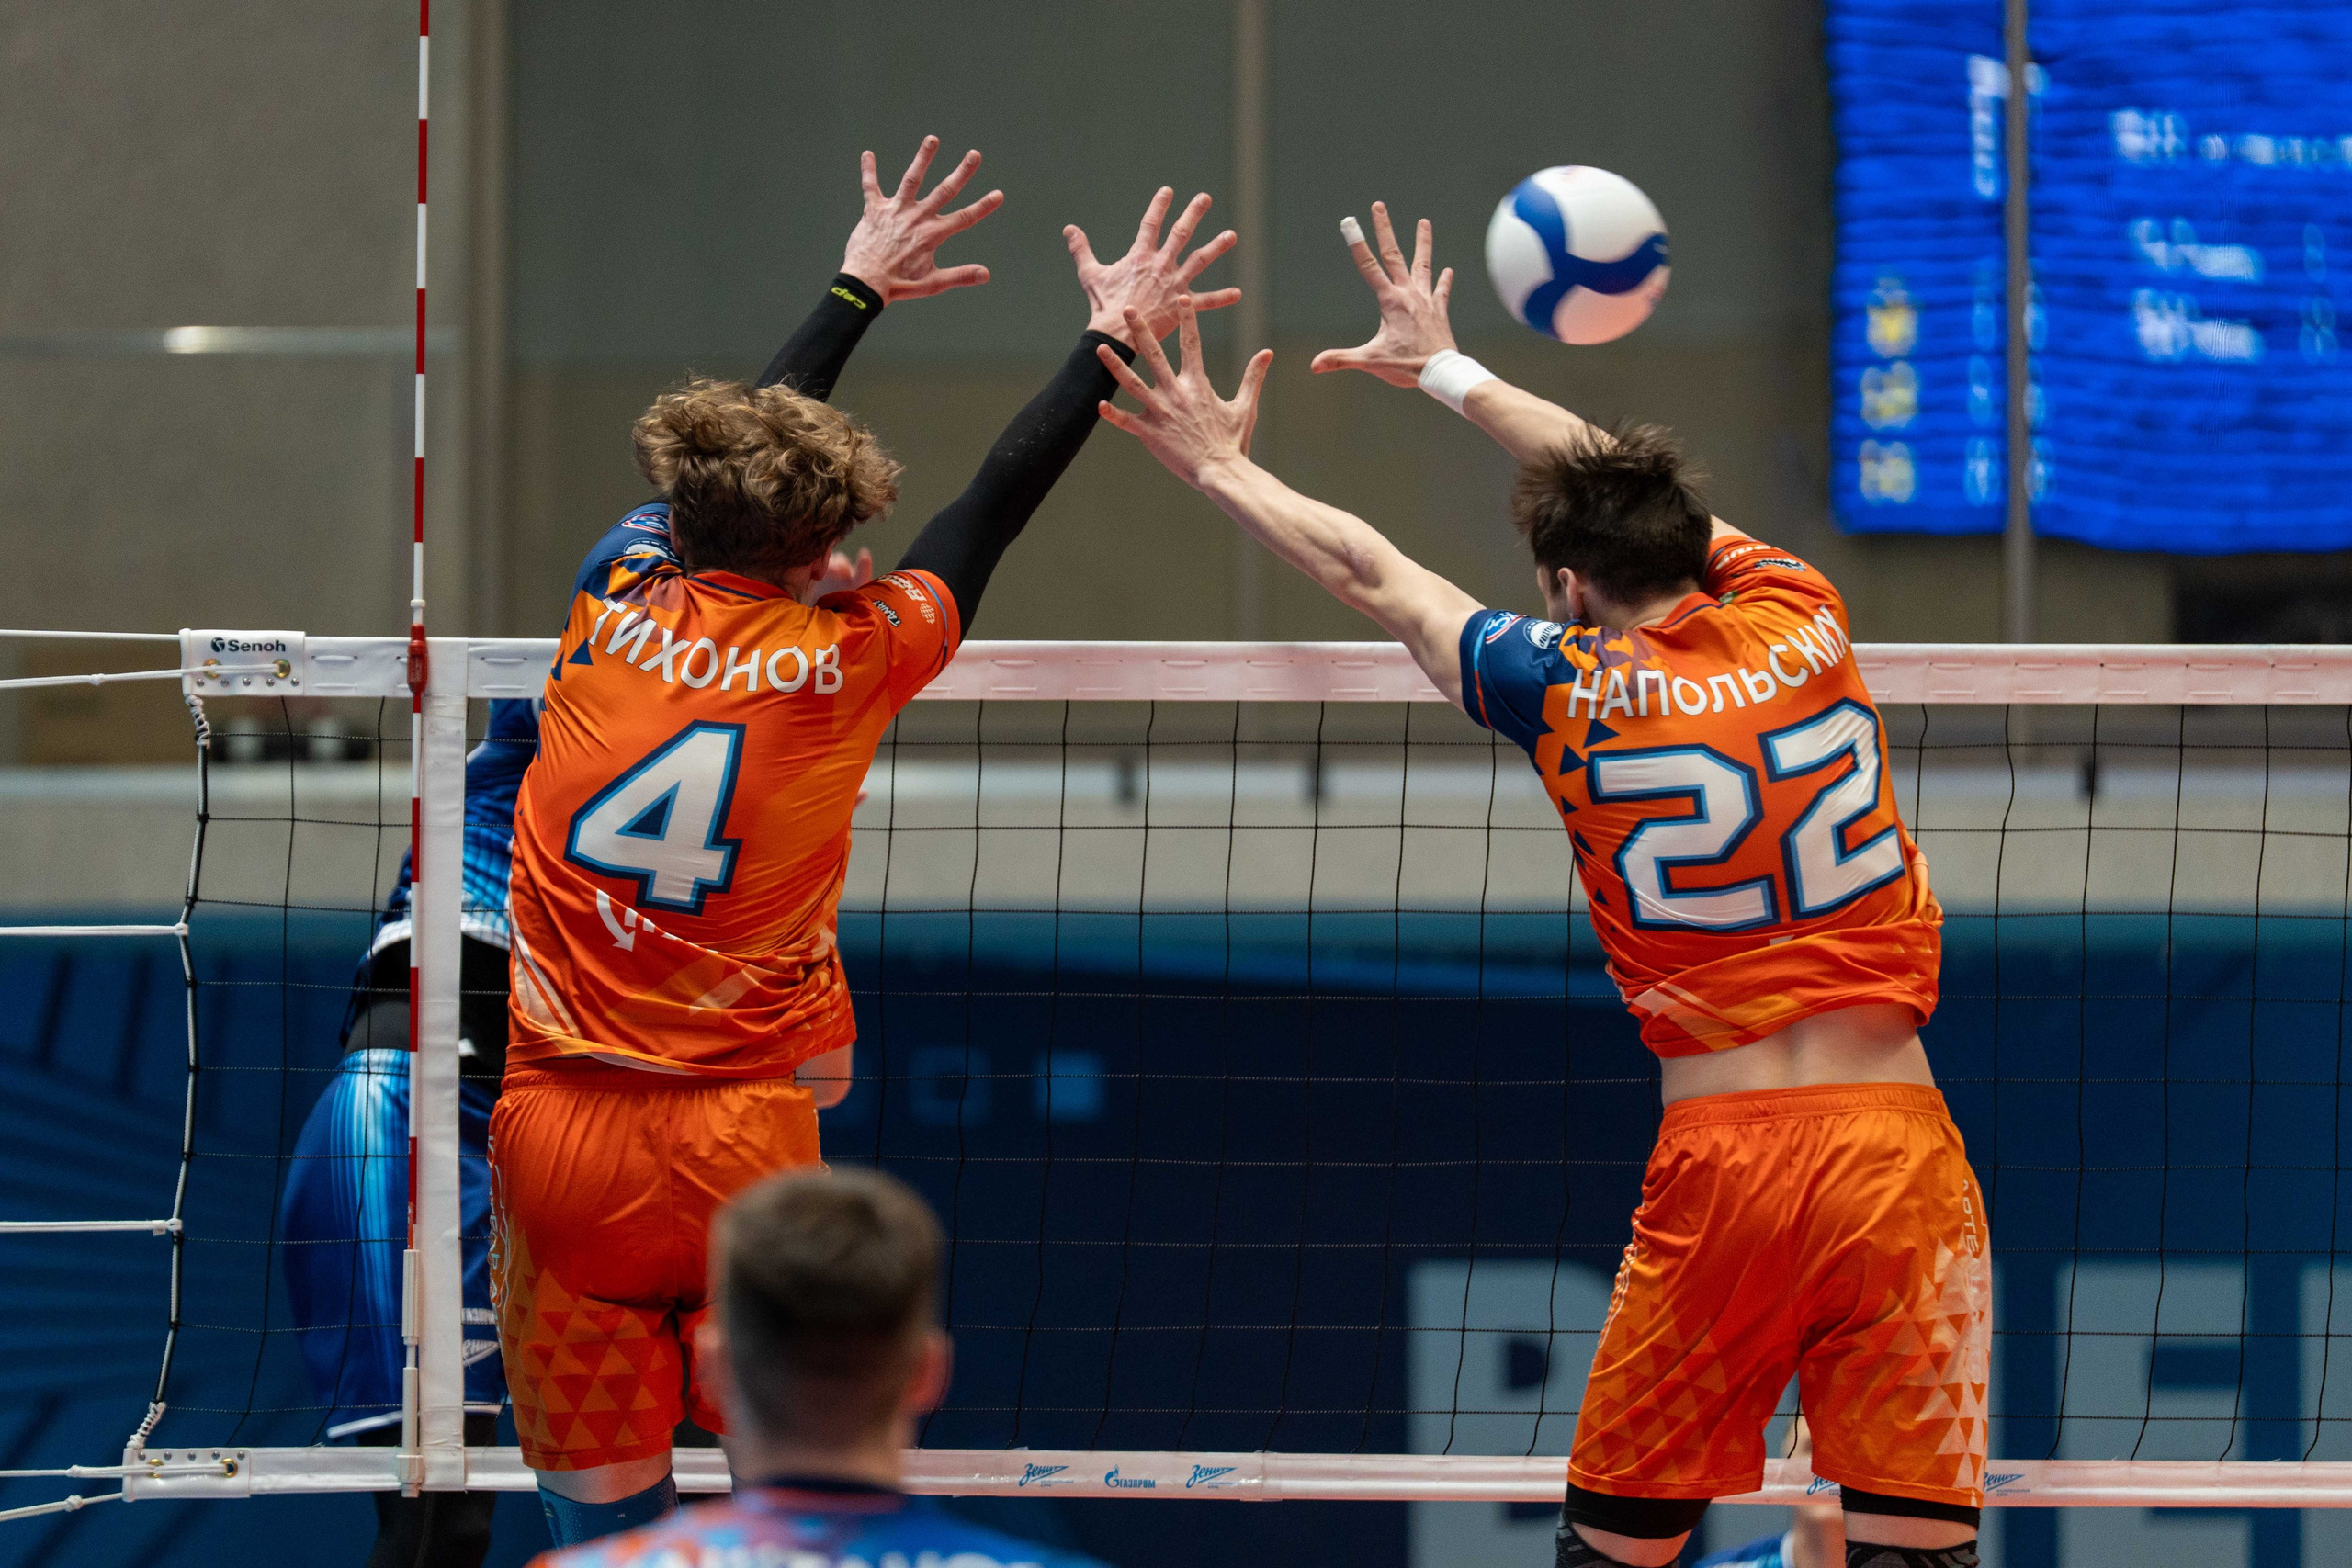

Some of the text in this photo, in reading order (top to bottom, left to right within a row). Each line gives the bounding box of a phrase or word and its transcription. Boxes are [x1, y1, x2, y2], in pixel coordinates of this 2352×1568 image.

[228, 639, 286, 652] Senoh
[588, 597, 844, 694] ТИХОНОВ
[563, 719, 747, 917] 4
[1586, 697, 1906, 932] 22
[1984, 1472, 2025, 1492] енит
